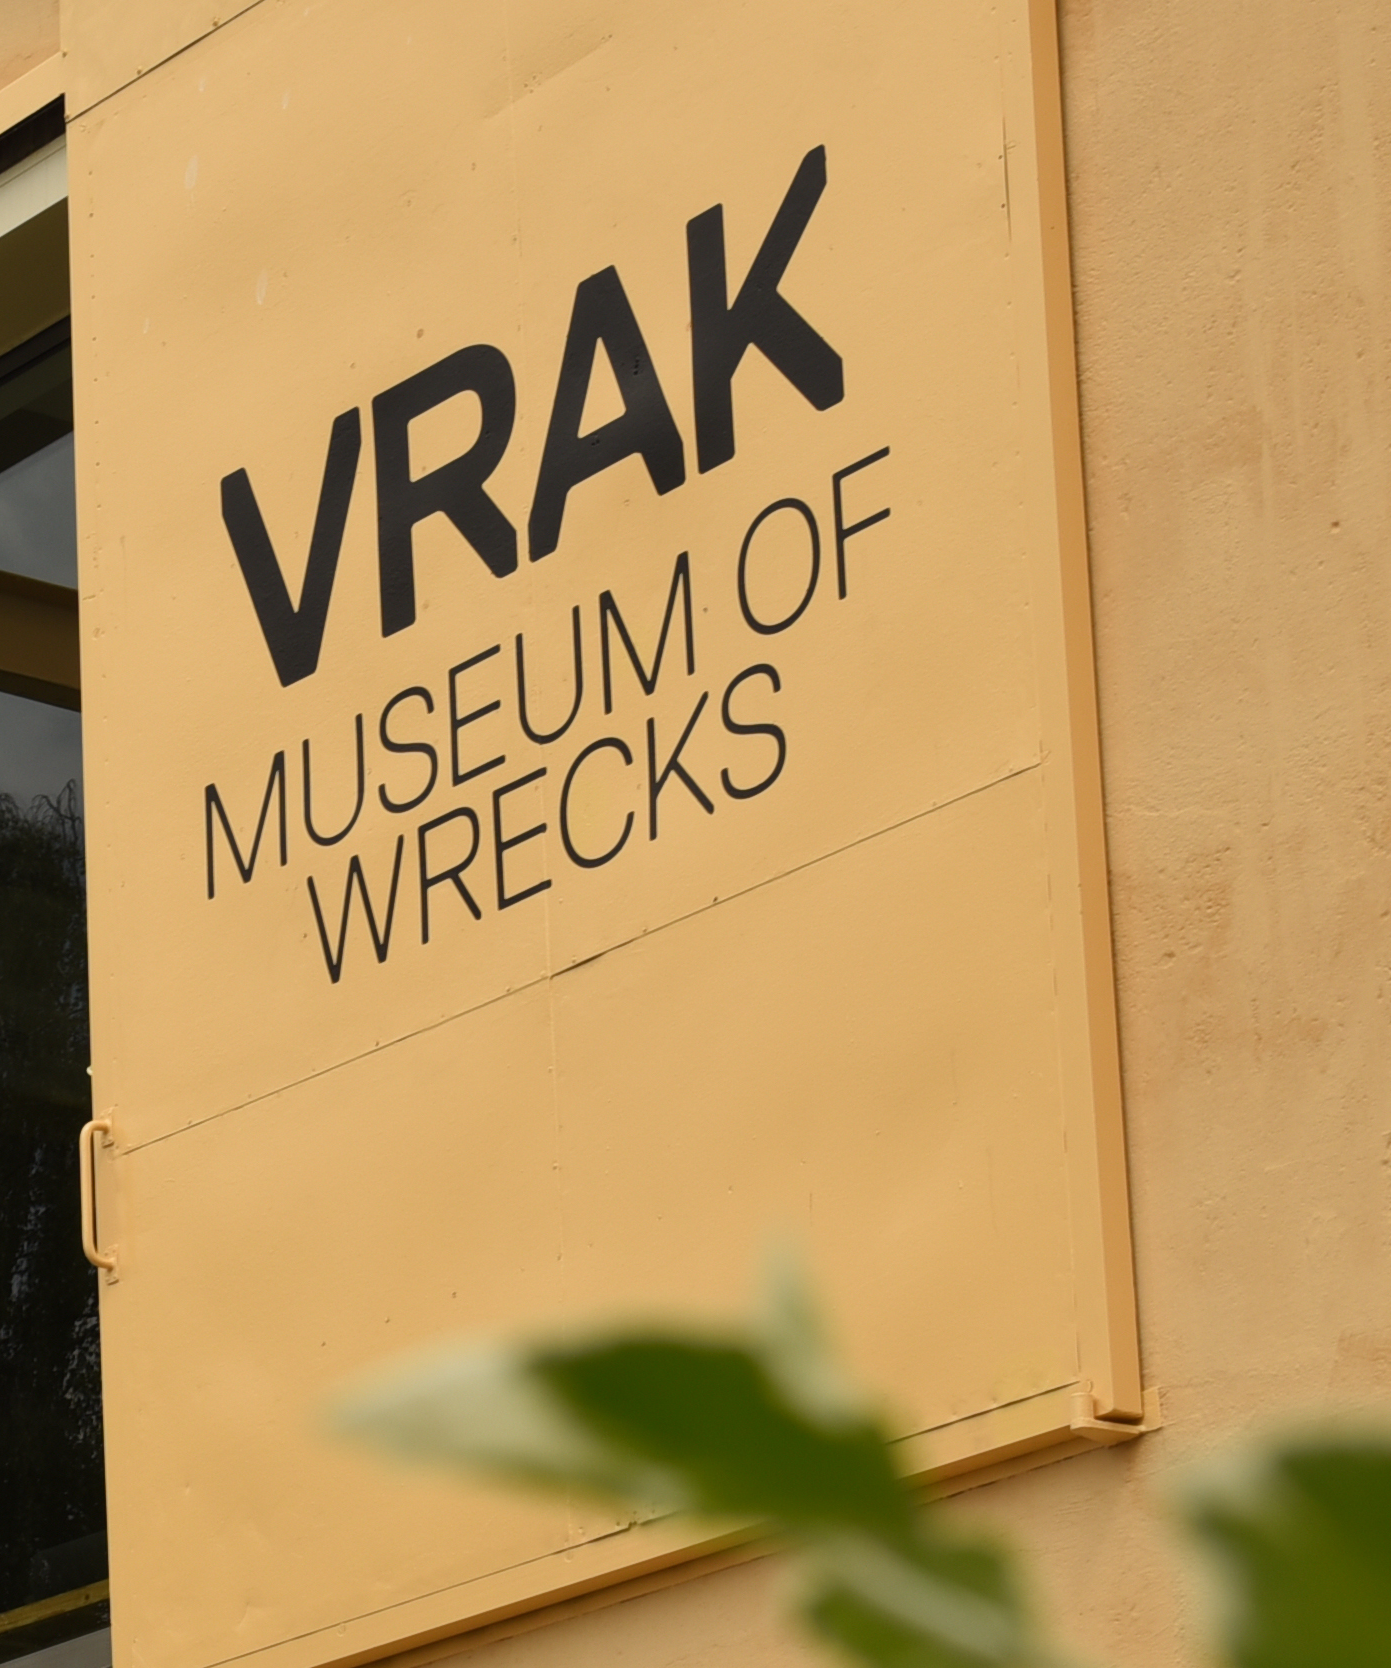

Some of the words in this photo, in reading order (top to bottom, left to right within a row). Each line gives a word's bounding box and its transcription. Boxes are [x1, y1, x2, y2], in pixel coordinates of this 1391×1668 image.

[220, 142, 845, 688] VRAK
[204, 550, 696, 901] MUSEUM
[737, 445, 892, 636] OF
[306, 662, 787, 985] WRECKS
